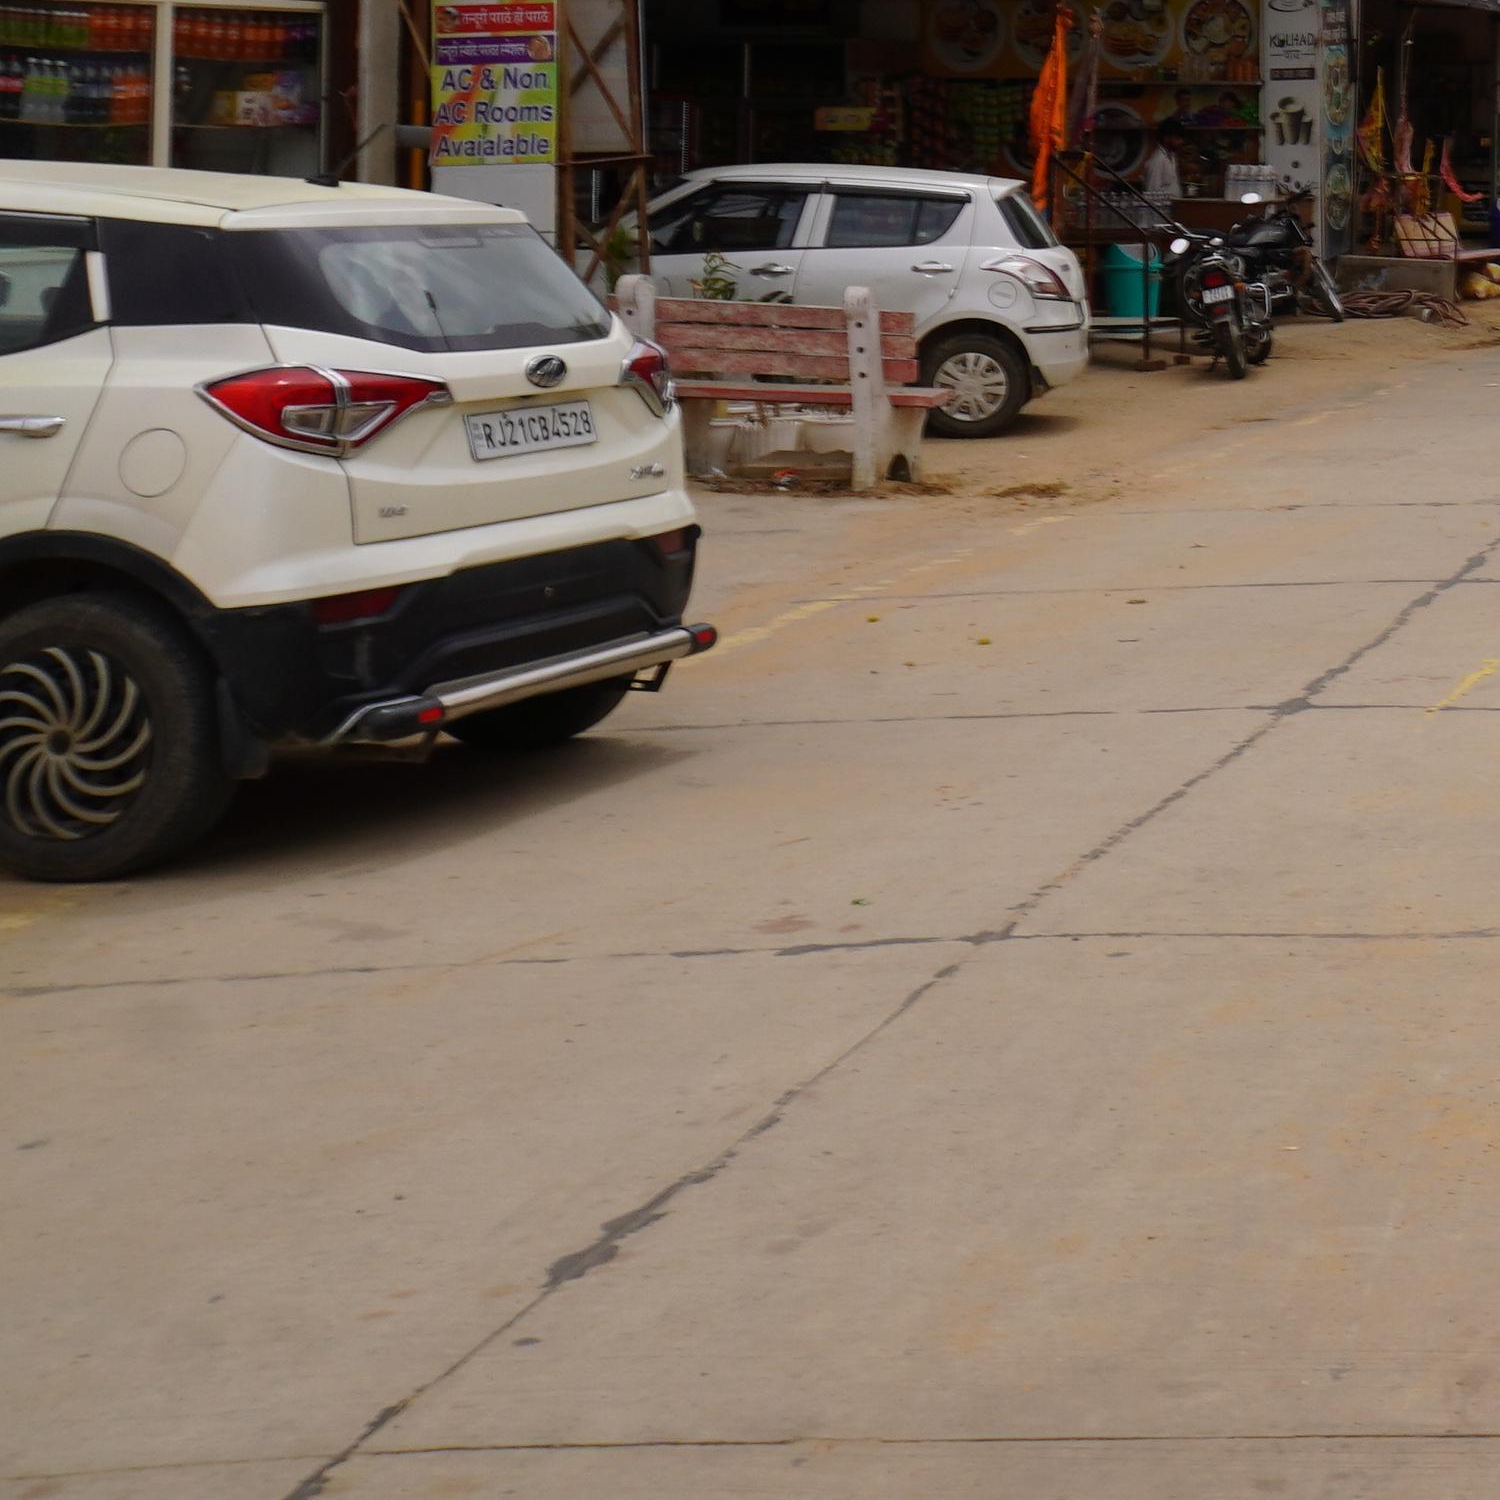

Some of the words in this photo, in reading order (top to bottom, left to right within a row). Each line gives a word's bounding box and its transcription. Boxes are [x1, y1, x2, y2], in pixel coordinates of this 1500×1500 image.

[441, 69, 473, 91] AC
[480, 68, 496, 90] &
[503, 68, 547, 89] Non
[435, 102, 466, 125] AC
[474, 102, 553, 123] Rooms
[482, 409, 591, 449] RJ21CB4528
